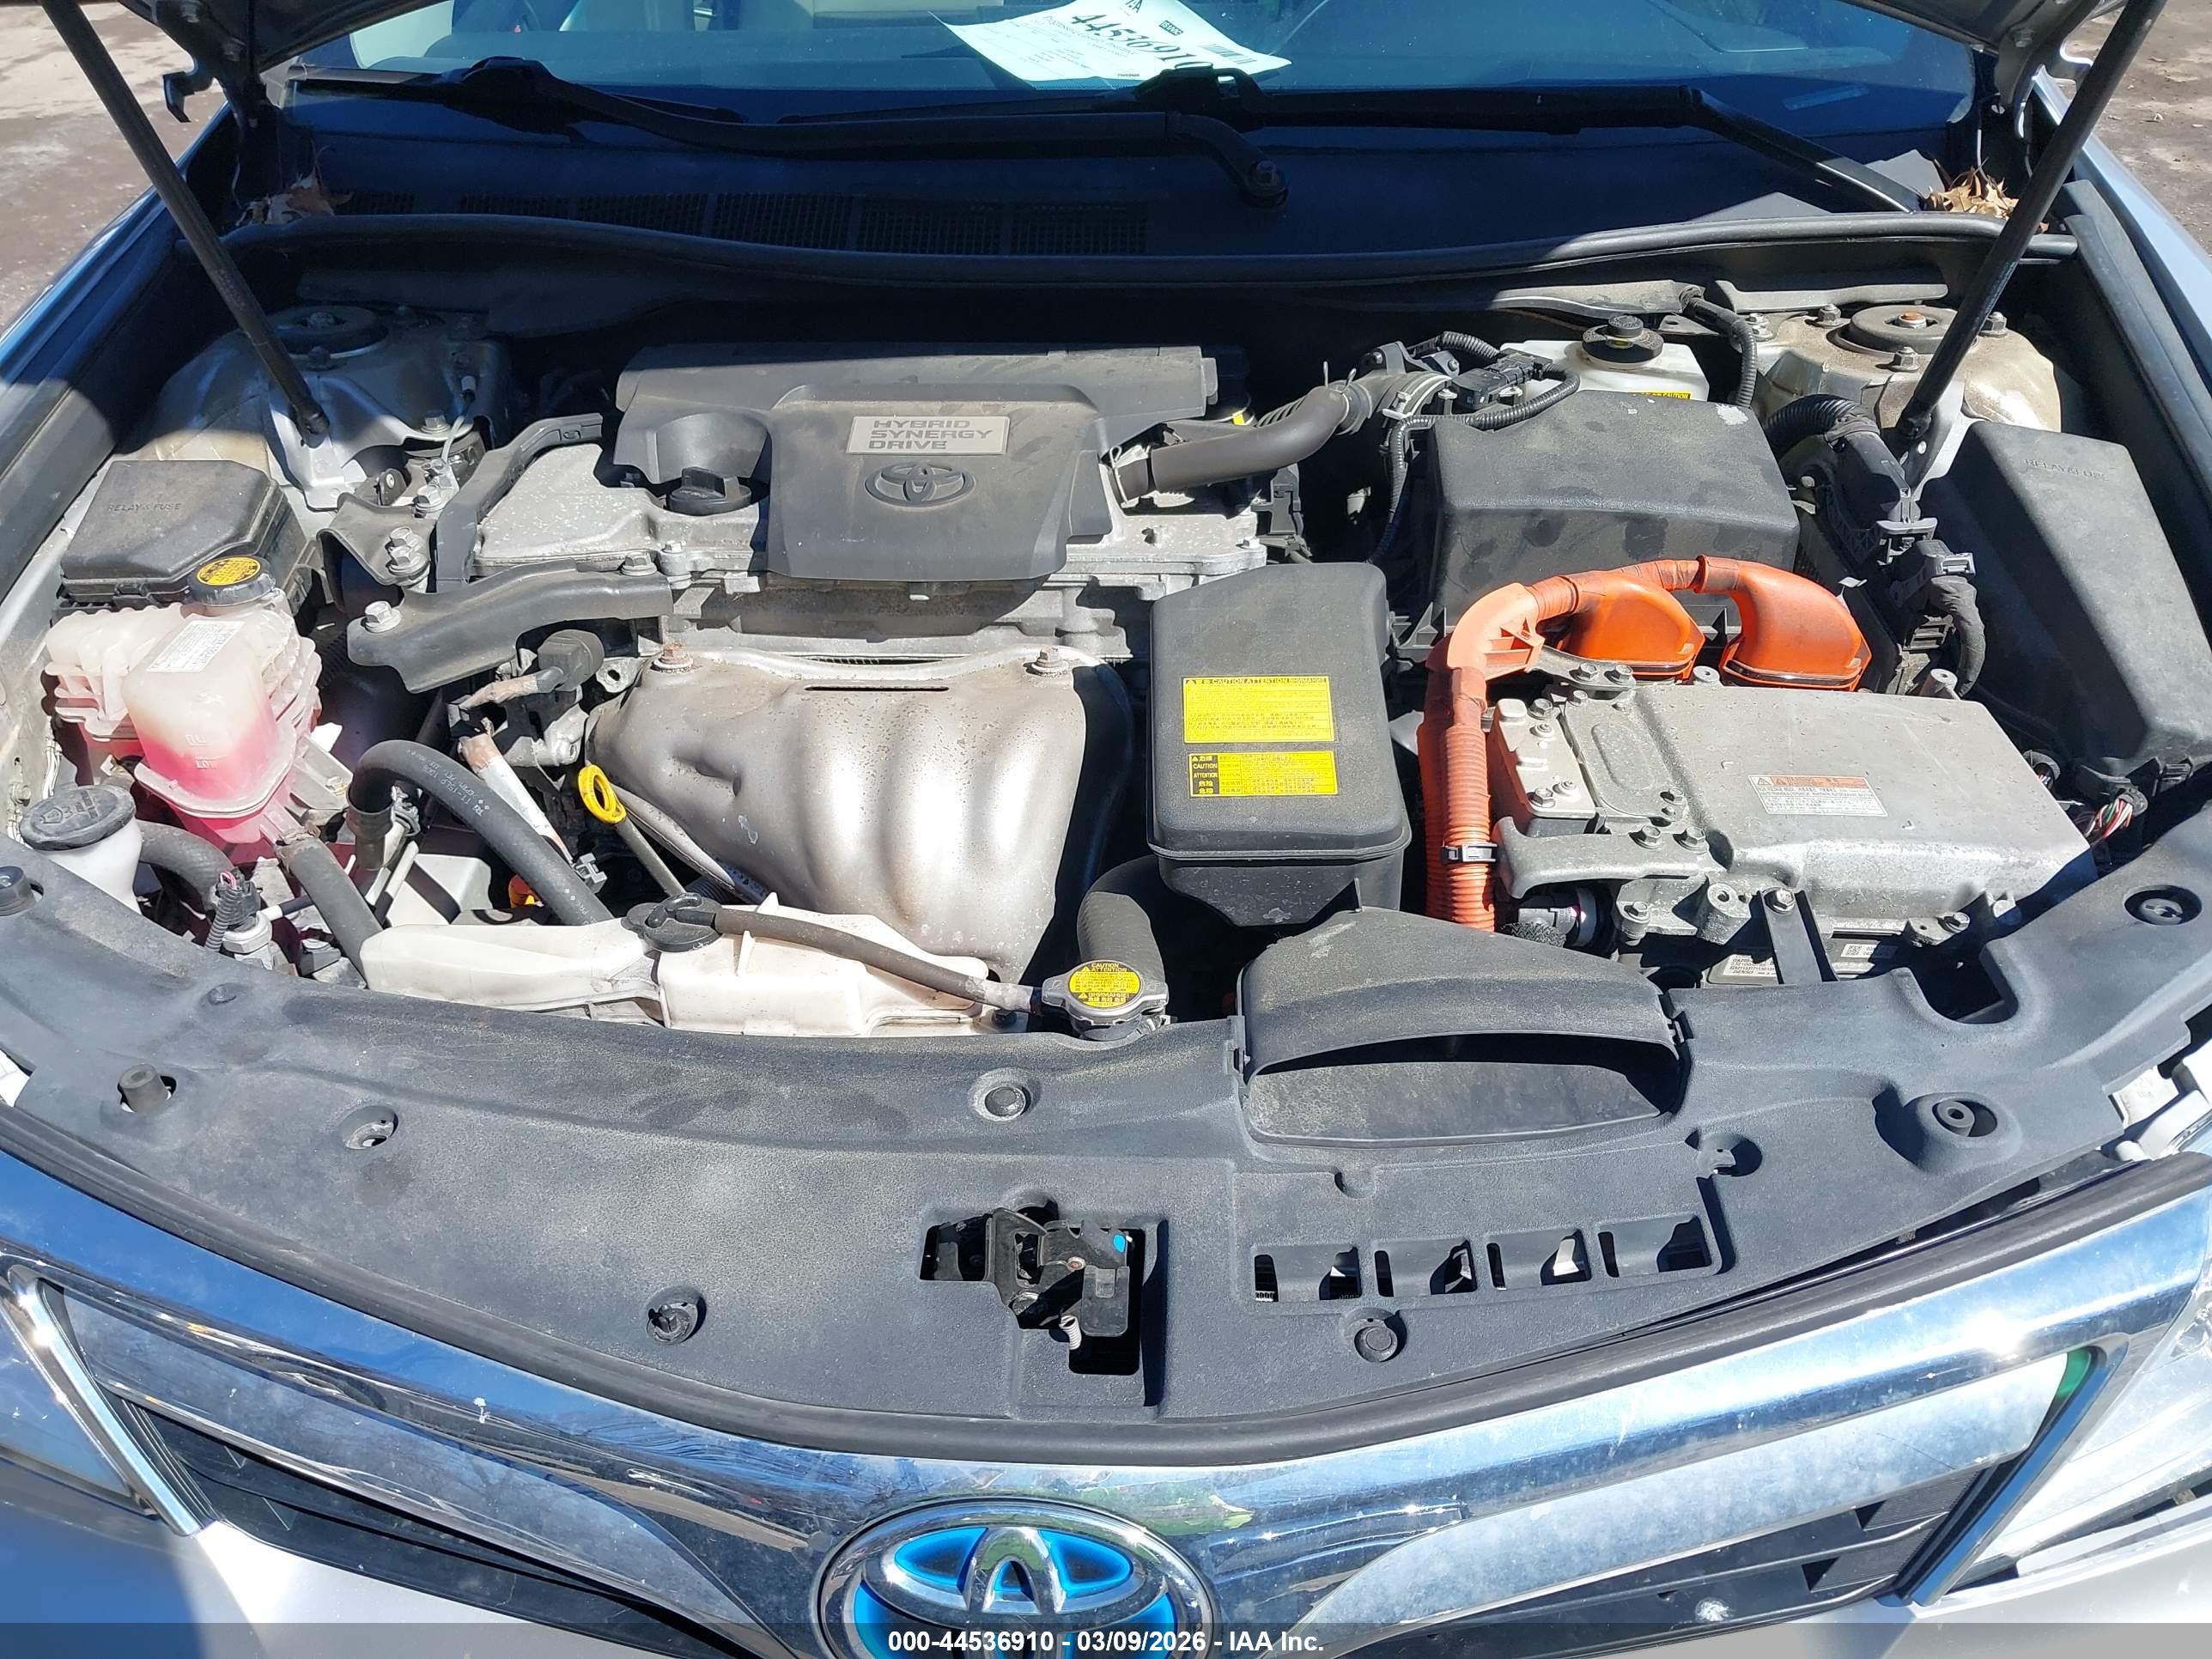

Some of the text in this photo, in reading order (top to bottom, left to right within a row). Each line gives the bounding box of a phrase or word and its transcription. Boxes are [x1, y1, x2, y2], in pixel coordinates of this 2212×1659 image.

[873, 420, 971, 428] HYBRID
[871, 429, 994, 439] SYNERGY
[868, 440, 948, 450] DRIVE
